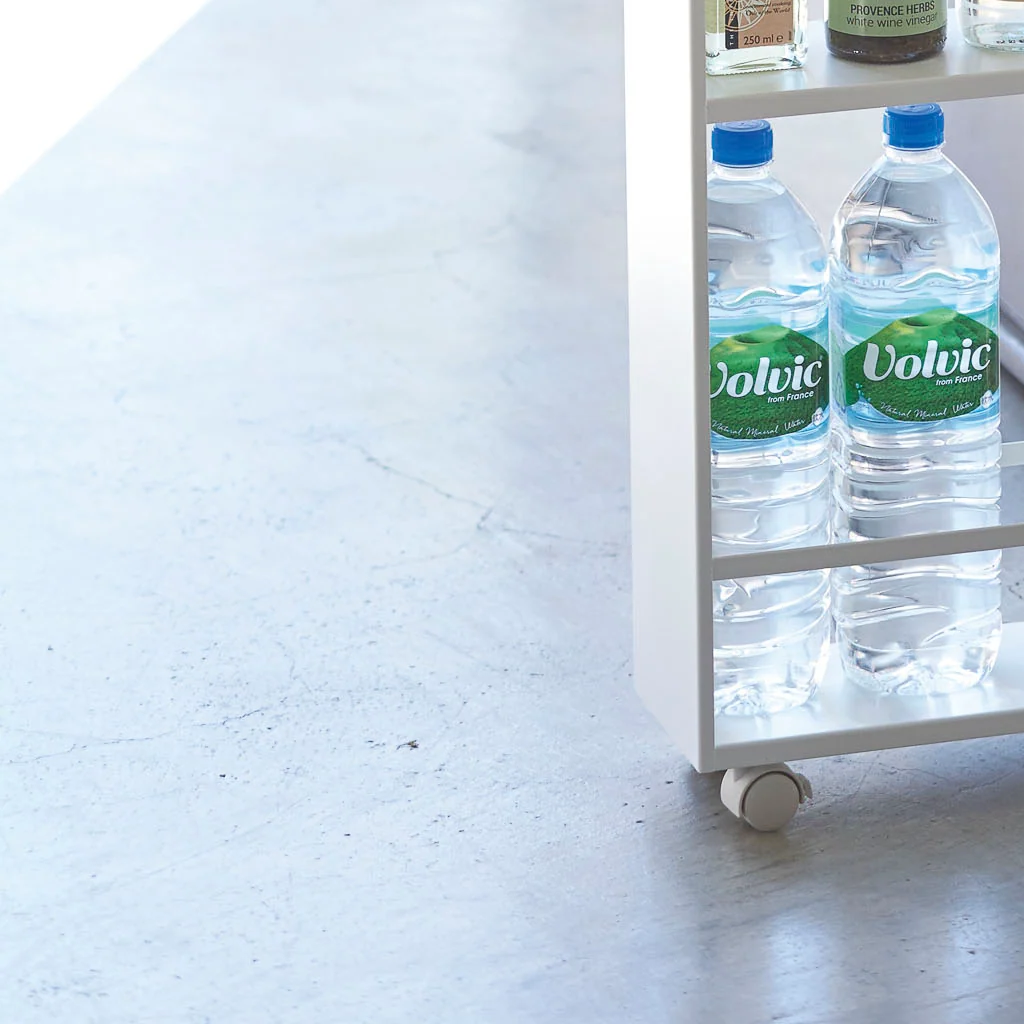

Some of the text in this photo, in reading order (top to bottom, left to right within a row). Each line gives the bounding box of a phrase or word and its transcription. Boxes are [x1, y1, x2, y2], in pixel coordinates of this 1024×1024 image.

[850, 0, 935, 17] PROVENCE HERBS
[846, 12, 938, 28] white wine vinegar
[743, 35, 760, 45] 250
[762, 34, 774, 44] ml
[863, 337, 992, 382] Volvic
[954, 373, 983, 384] France
[767, 390, 815, 404] from France
[880, 400, 974, 420] Natural Mineral Water
[711, 418, 806, 437] Natural Mineral Water
